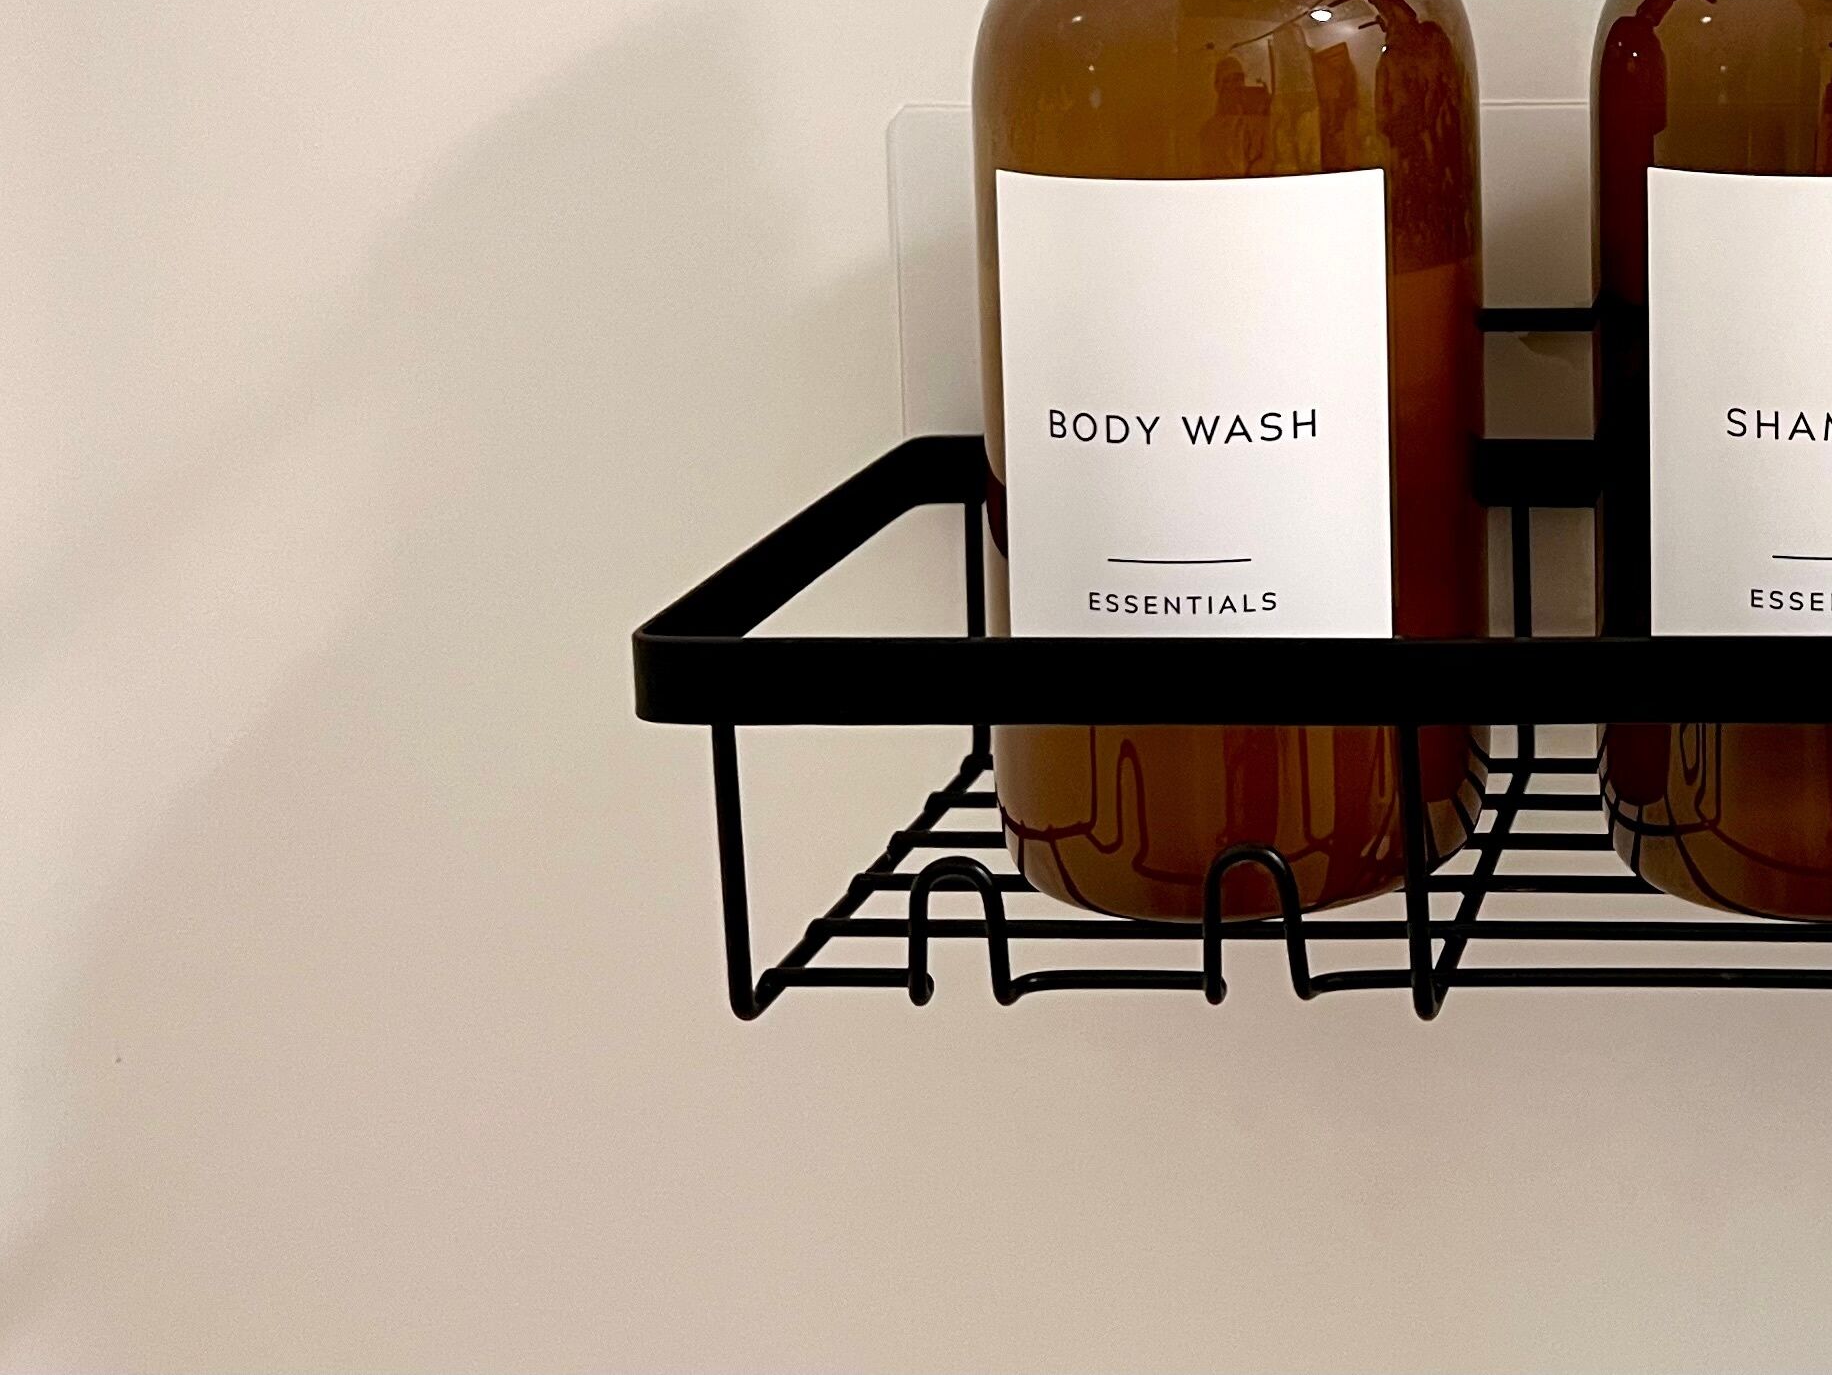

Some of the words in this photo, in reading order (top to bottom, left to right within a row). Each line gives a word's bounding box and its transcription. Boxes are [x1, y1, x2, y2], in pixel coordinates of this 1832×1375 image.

[1048, 407, 1162, 447] BODY
[1180, 407, 1319, 447] WASH
[1087, 590, 1279, 616] ESSENTIALS
